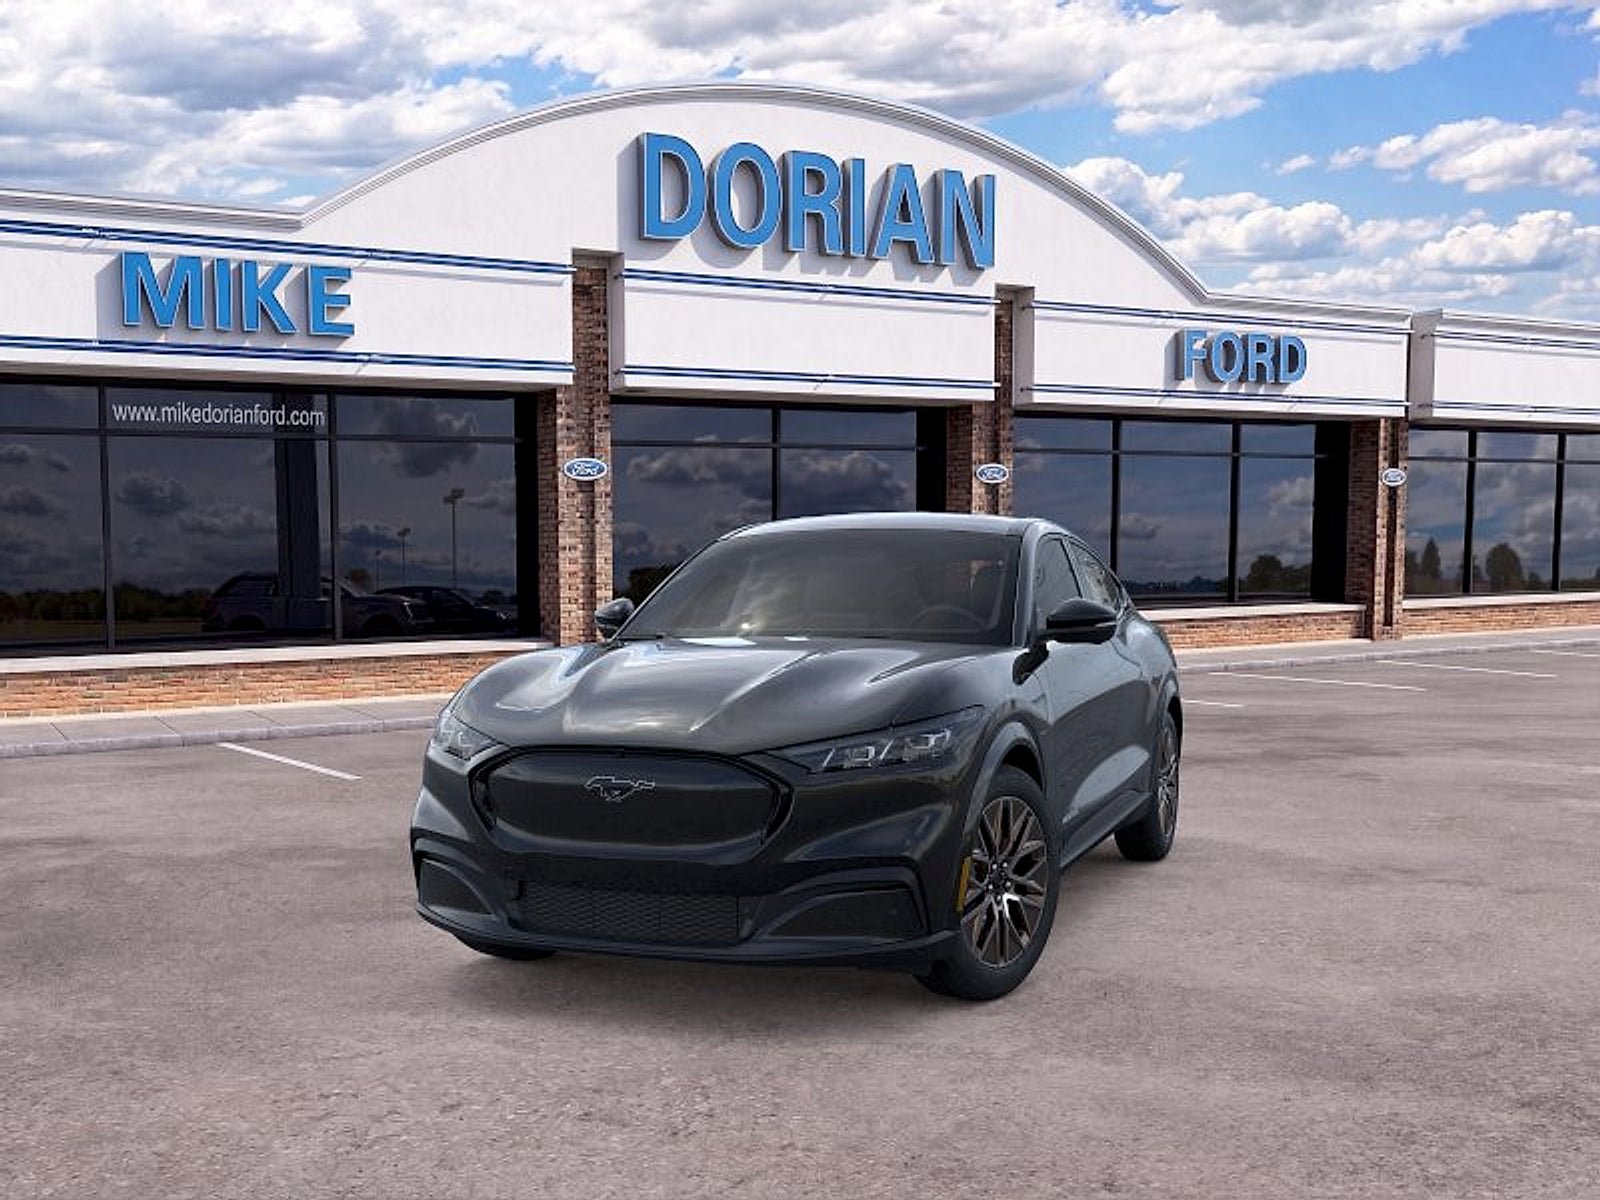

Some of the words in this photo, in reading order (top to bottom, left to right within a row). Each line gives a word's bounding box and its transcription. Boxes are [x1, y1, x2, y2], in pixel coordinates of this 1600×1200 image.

[640, 132, 996, 270] DORIAN
[122, 251, 355, 337] MIKE
[1180, 327, 1307, 384] FORD
[112, 402, 325, 426] www.mikedorianford.com
